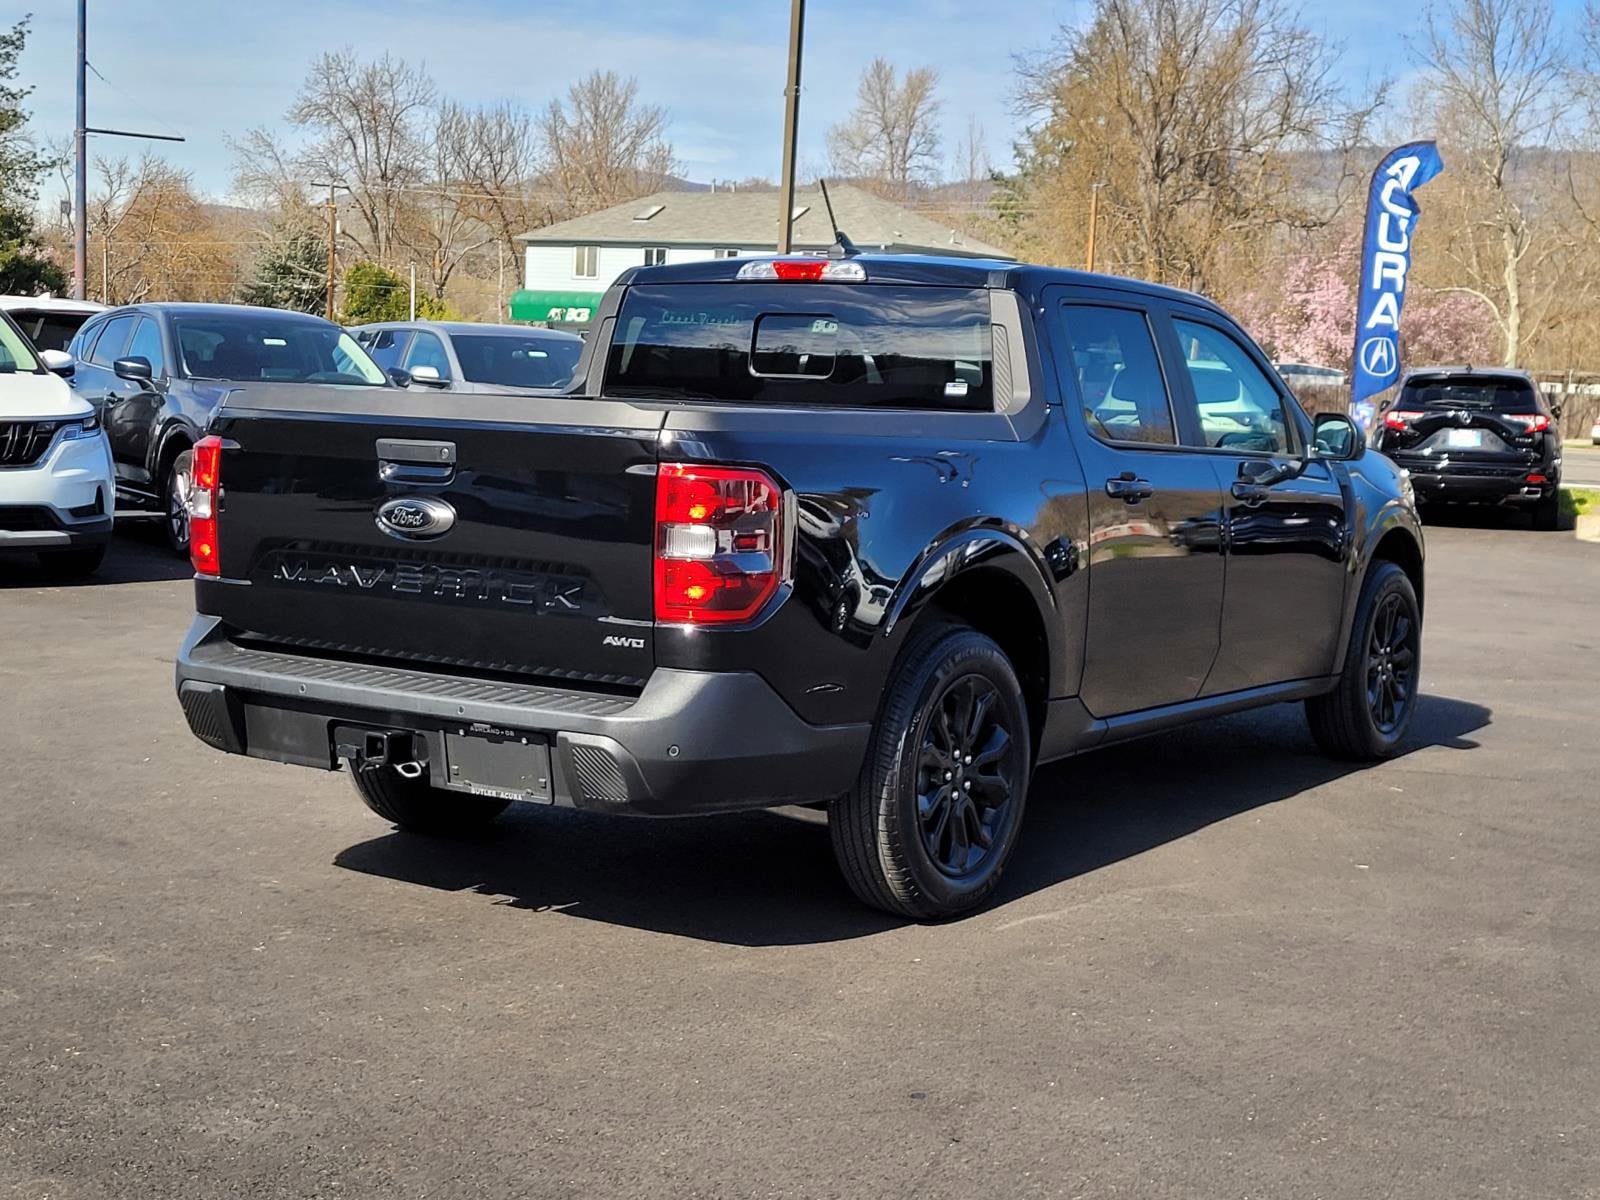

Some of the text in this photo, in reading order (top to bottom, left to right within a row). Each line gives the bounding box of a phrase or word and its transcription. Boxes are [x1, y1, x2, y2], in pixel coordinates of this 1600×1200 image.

[1365, 155, 1421, 332] ACURA
[391, 506, 424, 526] Ford
[272, 554, 584, 610] MAVERICK
[602, 635, 645, 649] AWD
